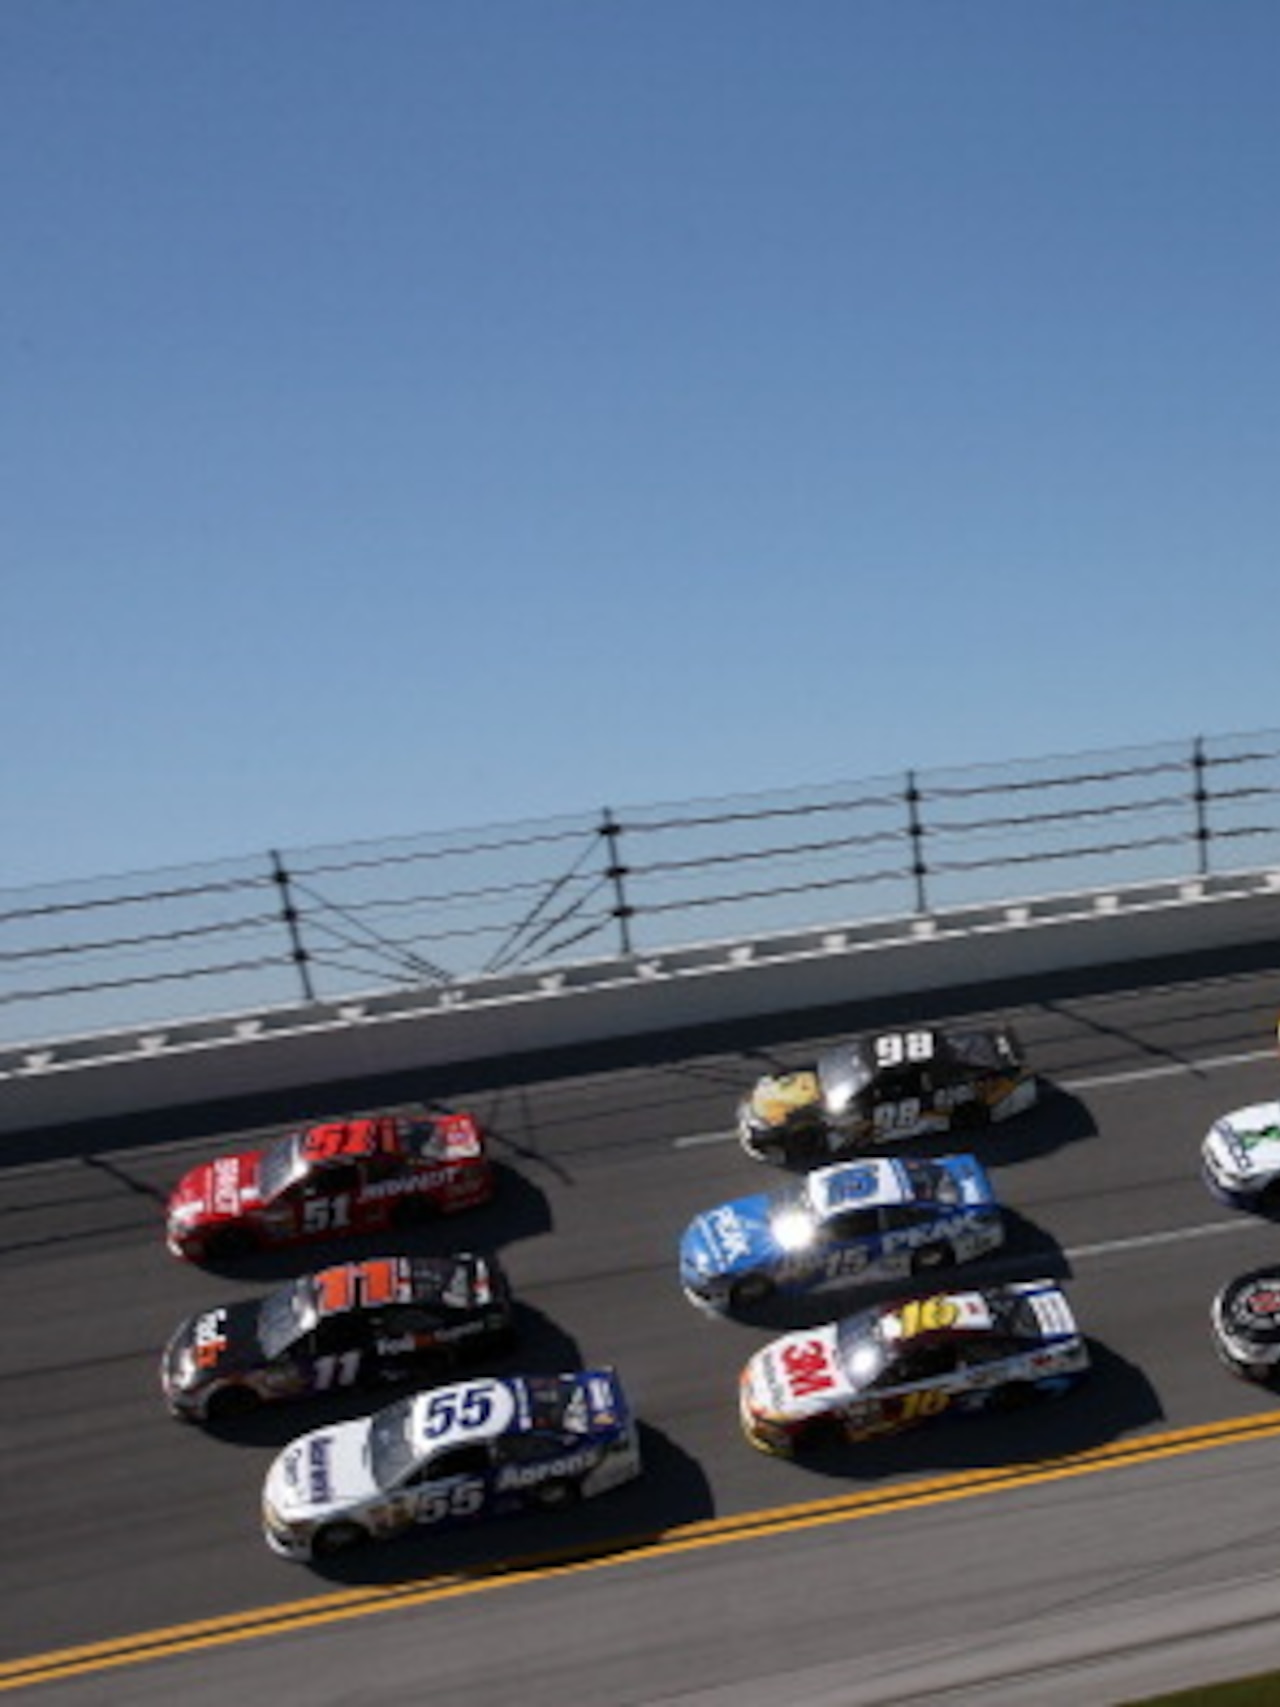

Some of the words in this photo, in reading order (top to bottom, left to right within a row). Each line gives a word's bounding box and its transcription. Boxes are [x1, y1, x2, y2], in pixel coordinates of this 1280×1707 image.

[875, 1031, 934, 1067] 98
[874, 1098, 920, 1130] 98
[303, 1120, 377, 1161] 51
[303, 1194, 352, 1232] 51
[315, 1259, 397, 1314] 11
[314, 1350, 360, 1389] 11
[781, 1339, 837, 1398] 3M
[424, 1386, 496, 1440] 55
[412, 1478, 485, 1524] 55
